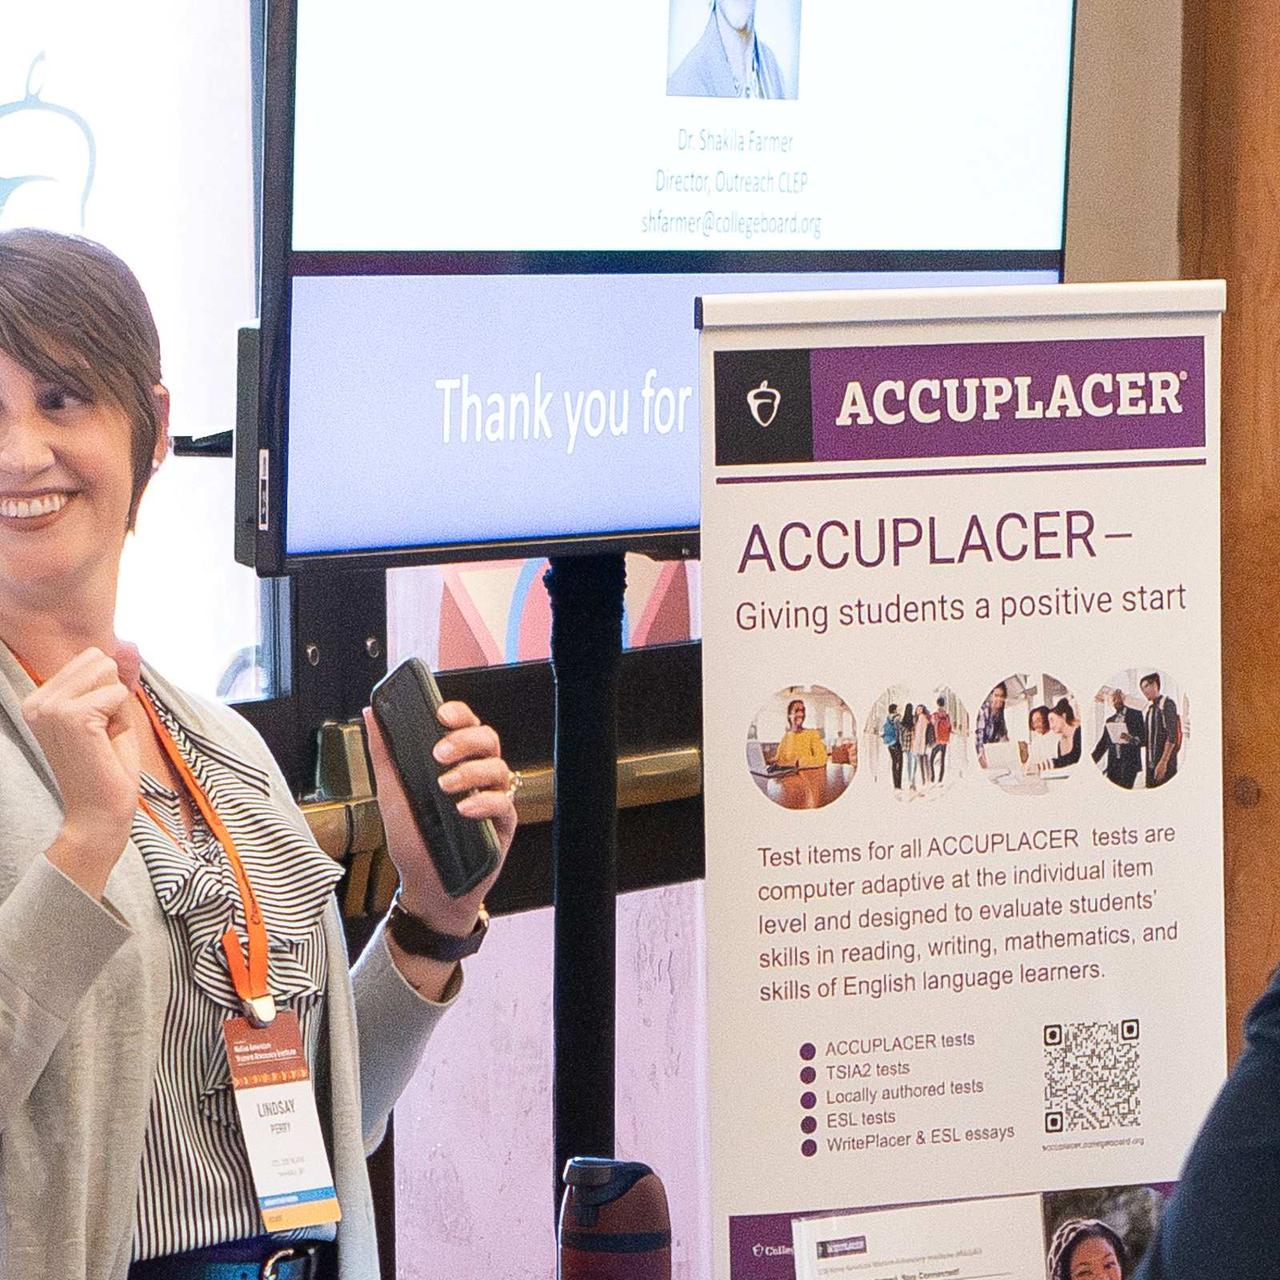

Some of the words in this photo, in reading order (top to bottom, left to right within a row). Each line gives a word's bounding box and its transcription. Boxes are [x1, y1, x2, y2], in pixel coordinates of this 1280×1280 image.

[677, 127, 694, 152] Dr.
[699, 127, 745, 153] Shakila
[748, 129, 795, 153] Farmer
[655, 167, 711, 196] Director,
[715, 169, 775, 194] Outreach
[778, 170, 809, 194] CLEP
[640, 208, 823, 241] shfarmer@collegeboard.org
[434, 373, 552, 444] Thank
[564, 388, 628, 454] you
[641, 369, 692, 435] for
[735, 600, 830, 634] Giving
[838, 592, 965, 627] students
[975, 597, 991, 620] a
[1000, 586, 1113, 625] positive
[1121, 583, 1187, 612] start
[758, 846, 802, 868] Test
[807, 841, 862, 864] items
[867, 839, 894, 861] for
[900, 837, 922, 859] all
[927, 828, 1080, 859] ACCUPLACER
[1091, 826, 1139, 847] tests
[1144, 825, 1176, 844] are
[757, 877, 855, 903] computer
[861, 871, 946, 897] adaptive
[952, 870, 971, 890] at
[976, 865, 1008, 888] the
[1013, 859, 1106, 885] individual
[1112, 858, 1154, 880] item
[758, 913, 808, 936] level
[813, 910, 852, 932] and
[858, 902, 948, 931] designed
[954, 903, 973, 923] to
[978, 896, 1063, 921] evaluate
[759, 945, 811, 969] skills
[817, 943, 835, 965] in
[841, 936, 922, 964] reading,
[928, 932, 998, 959] writing,
[1004, 925, 1137, 953] mathematics,
[1142, 921, 1179, 943] and
[759, 978, 811, 1002] skills
[817, 976, 838, 998] of
[843, 971, 917, 999] English
[922, 966, 1014, 993] language
[1019, 960, 1106, 984] learners.
[825, 1034, 937, 1057] ACCUPLACER
[941, 1031, 975, 1048] tests
[826, 1062, 872, 1081] TSIA2
[875, 1060, 910, 1077] tests
[826, 1087, 878, 1106] Locally
[882, 1081, 946, 1103] authored
[949, 1078, 984, 1096] tests
[256, 1099, 296, 1118] LINDSAY
[826, 1112, 858, 1129] ESL
[861, 1109, 896, 1127] tests
[826, 1131, 911, 1153] WritePlacer
[916, 1130, 926, 1146] &
[930, 1128, 961, 1144] ESL
[965, 1124, 1016, 1144] essays
